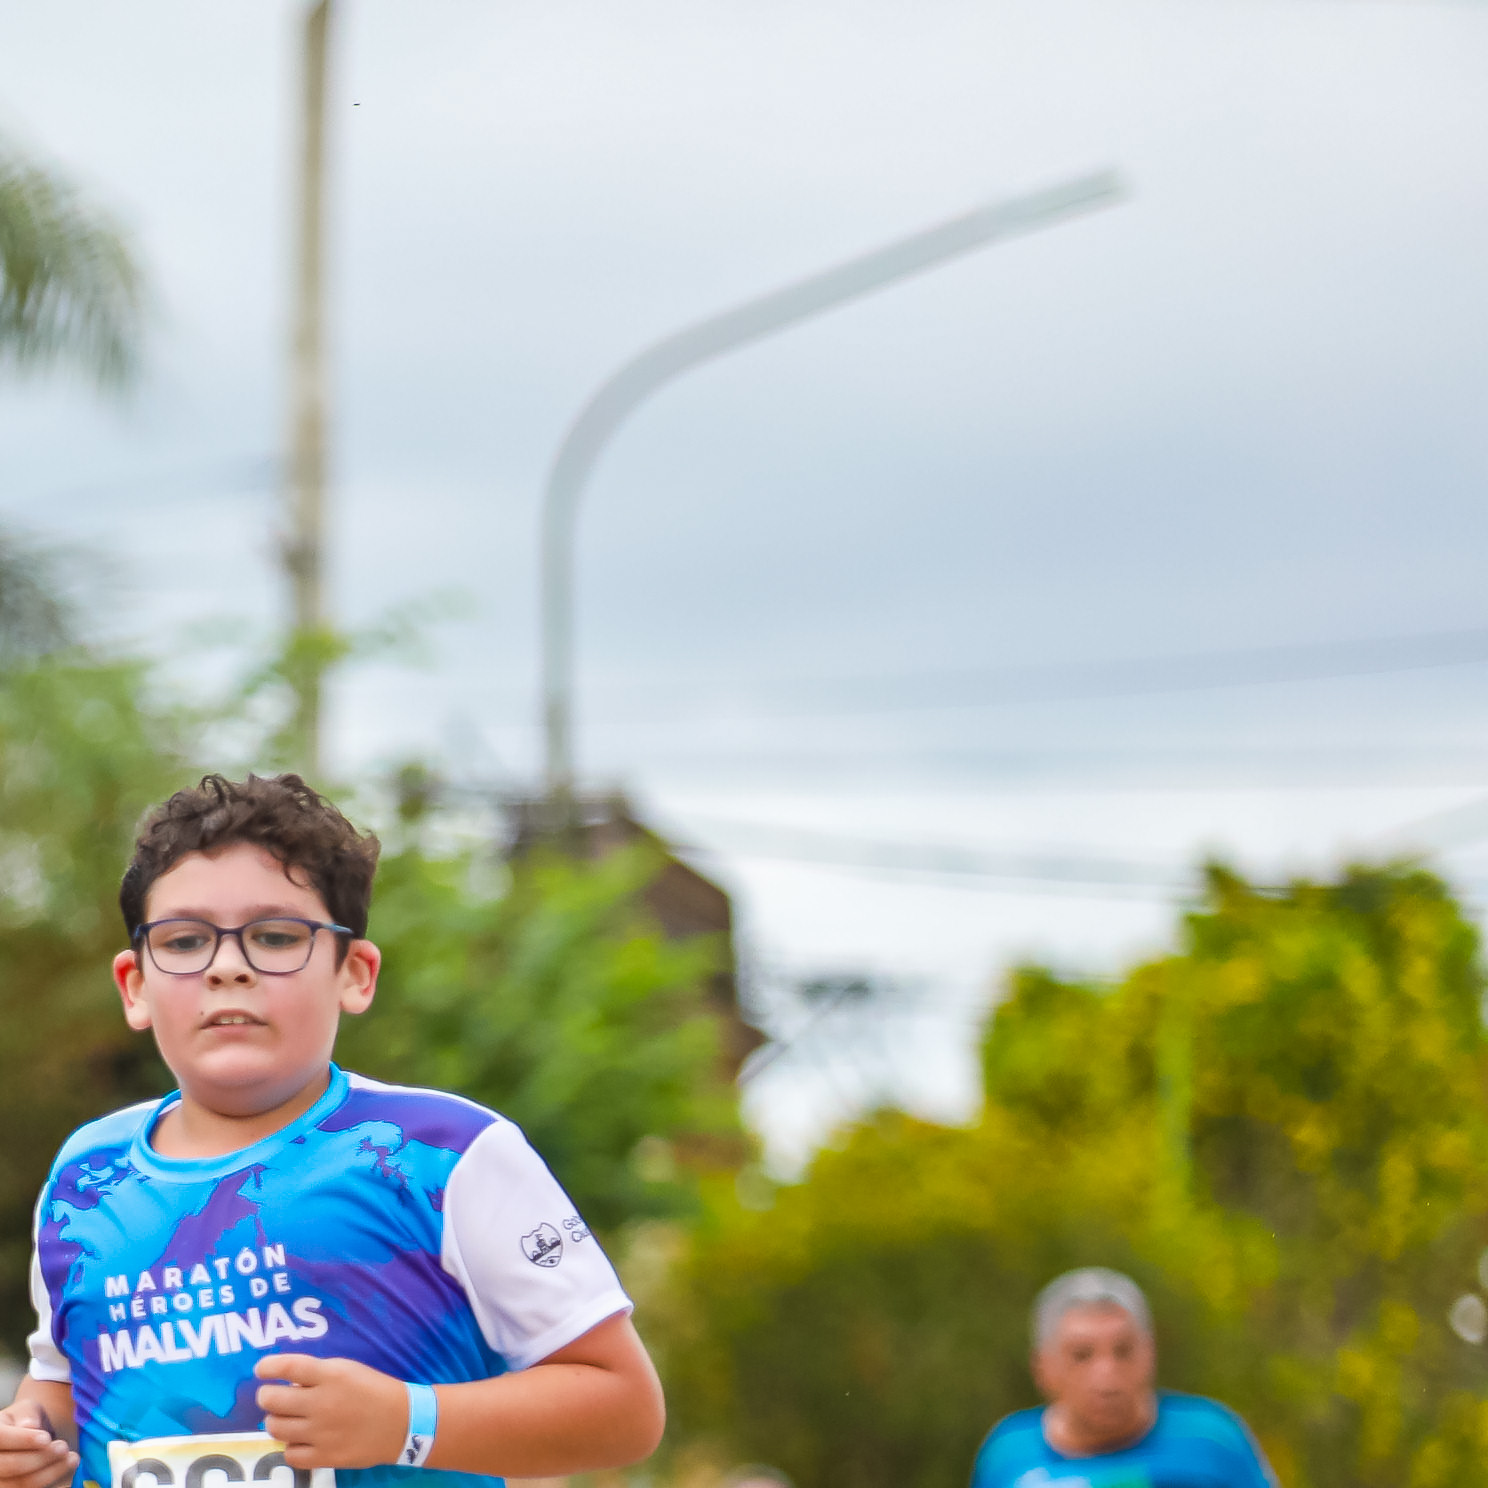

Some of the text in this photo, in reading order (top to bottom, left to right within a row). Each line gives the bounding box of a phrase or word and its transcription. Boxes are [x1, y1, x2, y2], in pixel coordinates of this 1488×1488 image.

[105, 1244, 287, 1298] MARATÓN
[109, 1272, 291, 1322] HÉROES DE
[98, 1297, 329, 1373] MALVINAS
